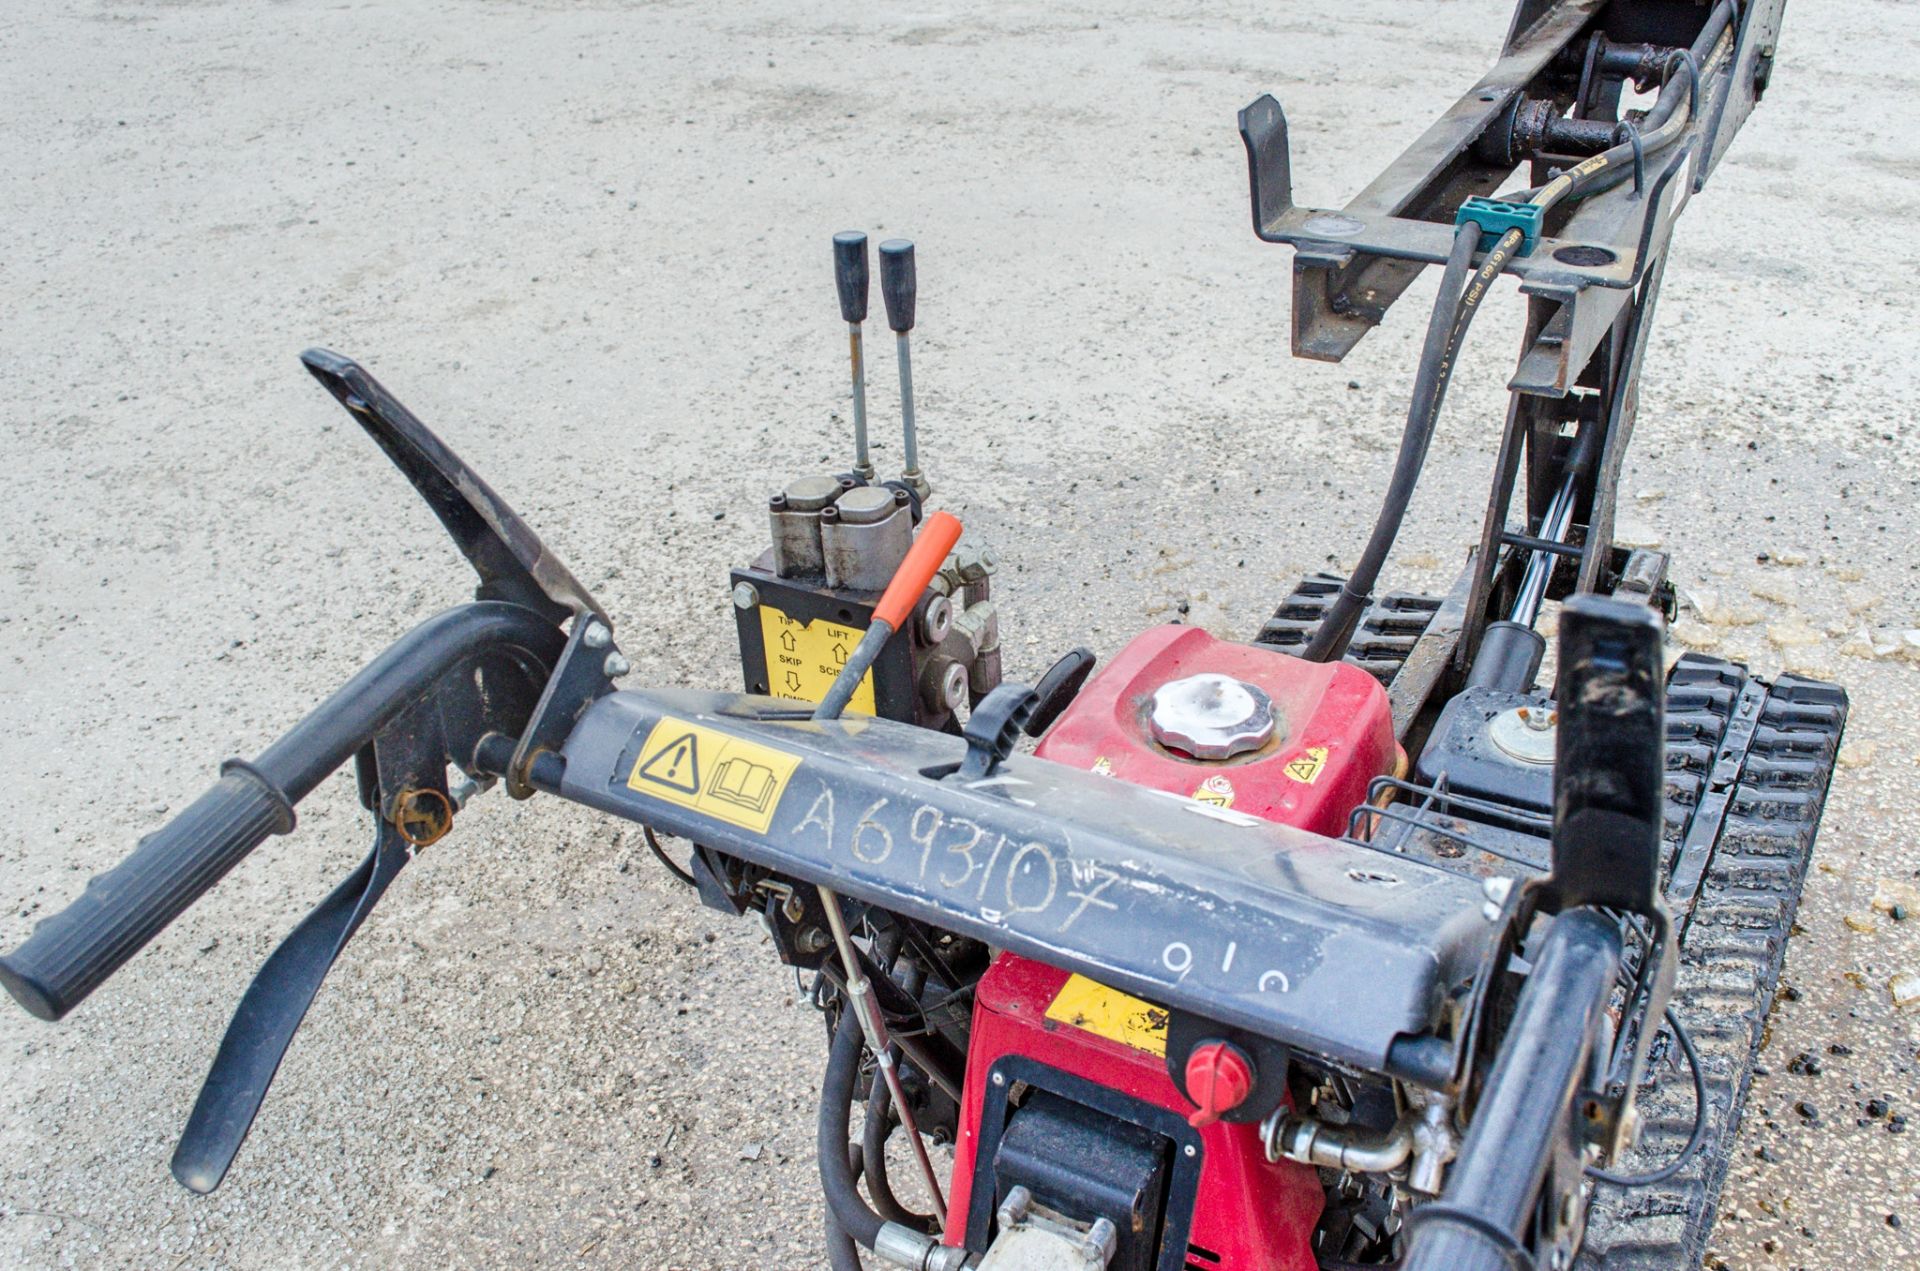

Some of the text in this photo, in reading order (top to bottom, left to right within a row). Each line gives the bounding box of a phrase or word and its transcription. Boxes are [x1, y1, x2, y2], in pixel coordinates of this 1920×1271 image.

[1465, 282, 1482, 306] PSI)
[827, 627, 849, 641] LIFT
[779, 654, 802, 667] SKIP
